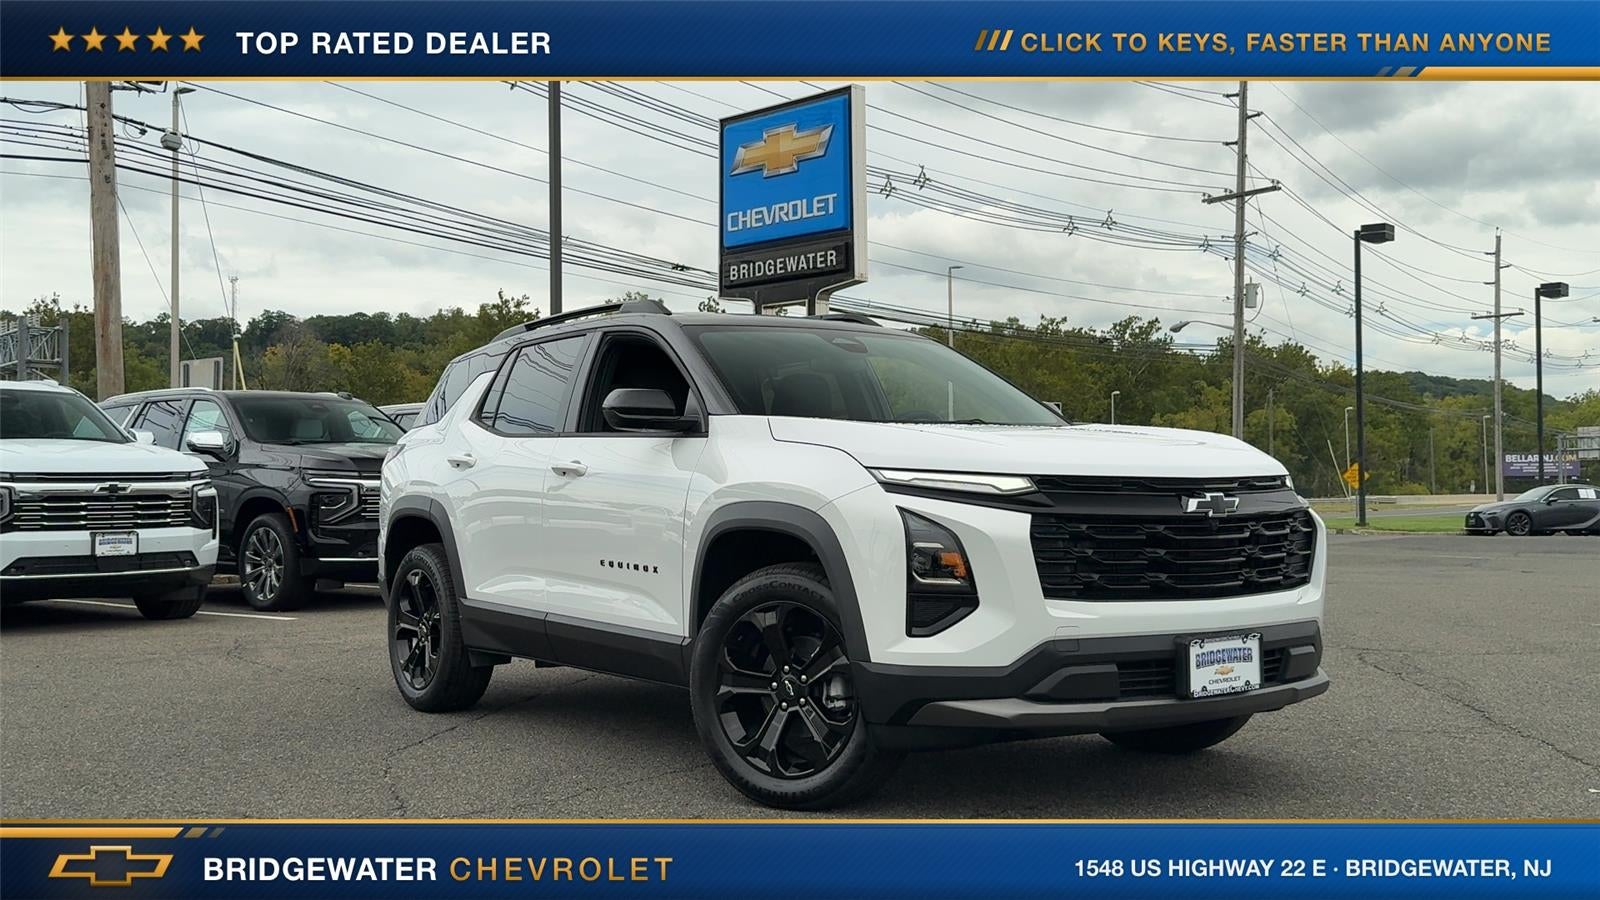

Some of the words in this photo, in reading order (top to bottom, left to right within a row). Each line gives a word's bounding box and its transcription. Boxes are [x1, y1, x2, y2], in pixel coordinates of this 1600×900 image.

[727, 193, 837, 232] CHEVROLET
[729, 249, 837, 281] BRIDGEWATER
[1505, 454, 1577, 463] BELLARNJ.COM
[599, 559, 659, 575] EQUINOX
[1195, 647, 1253, 669] BRIDGEWATER
[1208, 675, 1241, 685] CHEVROLET
